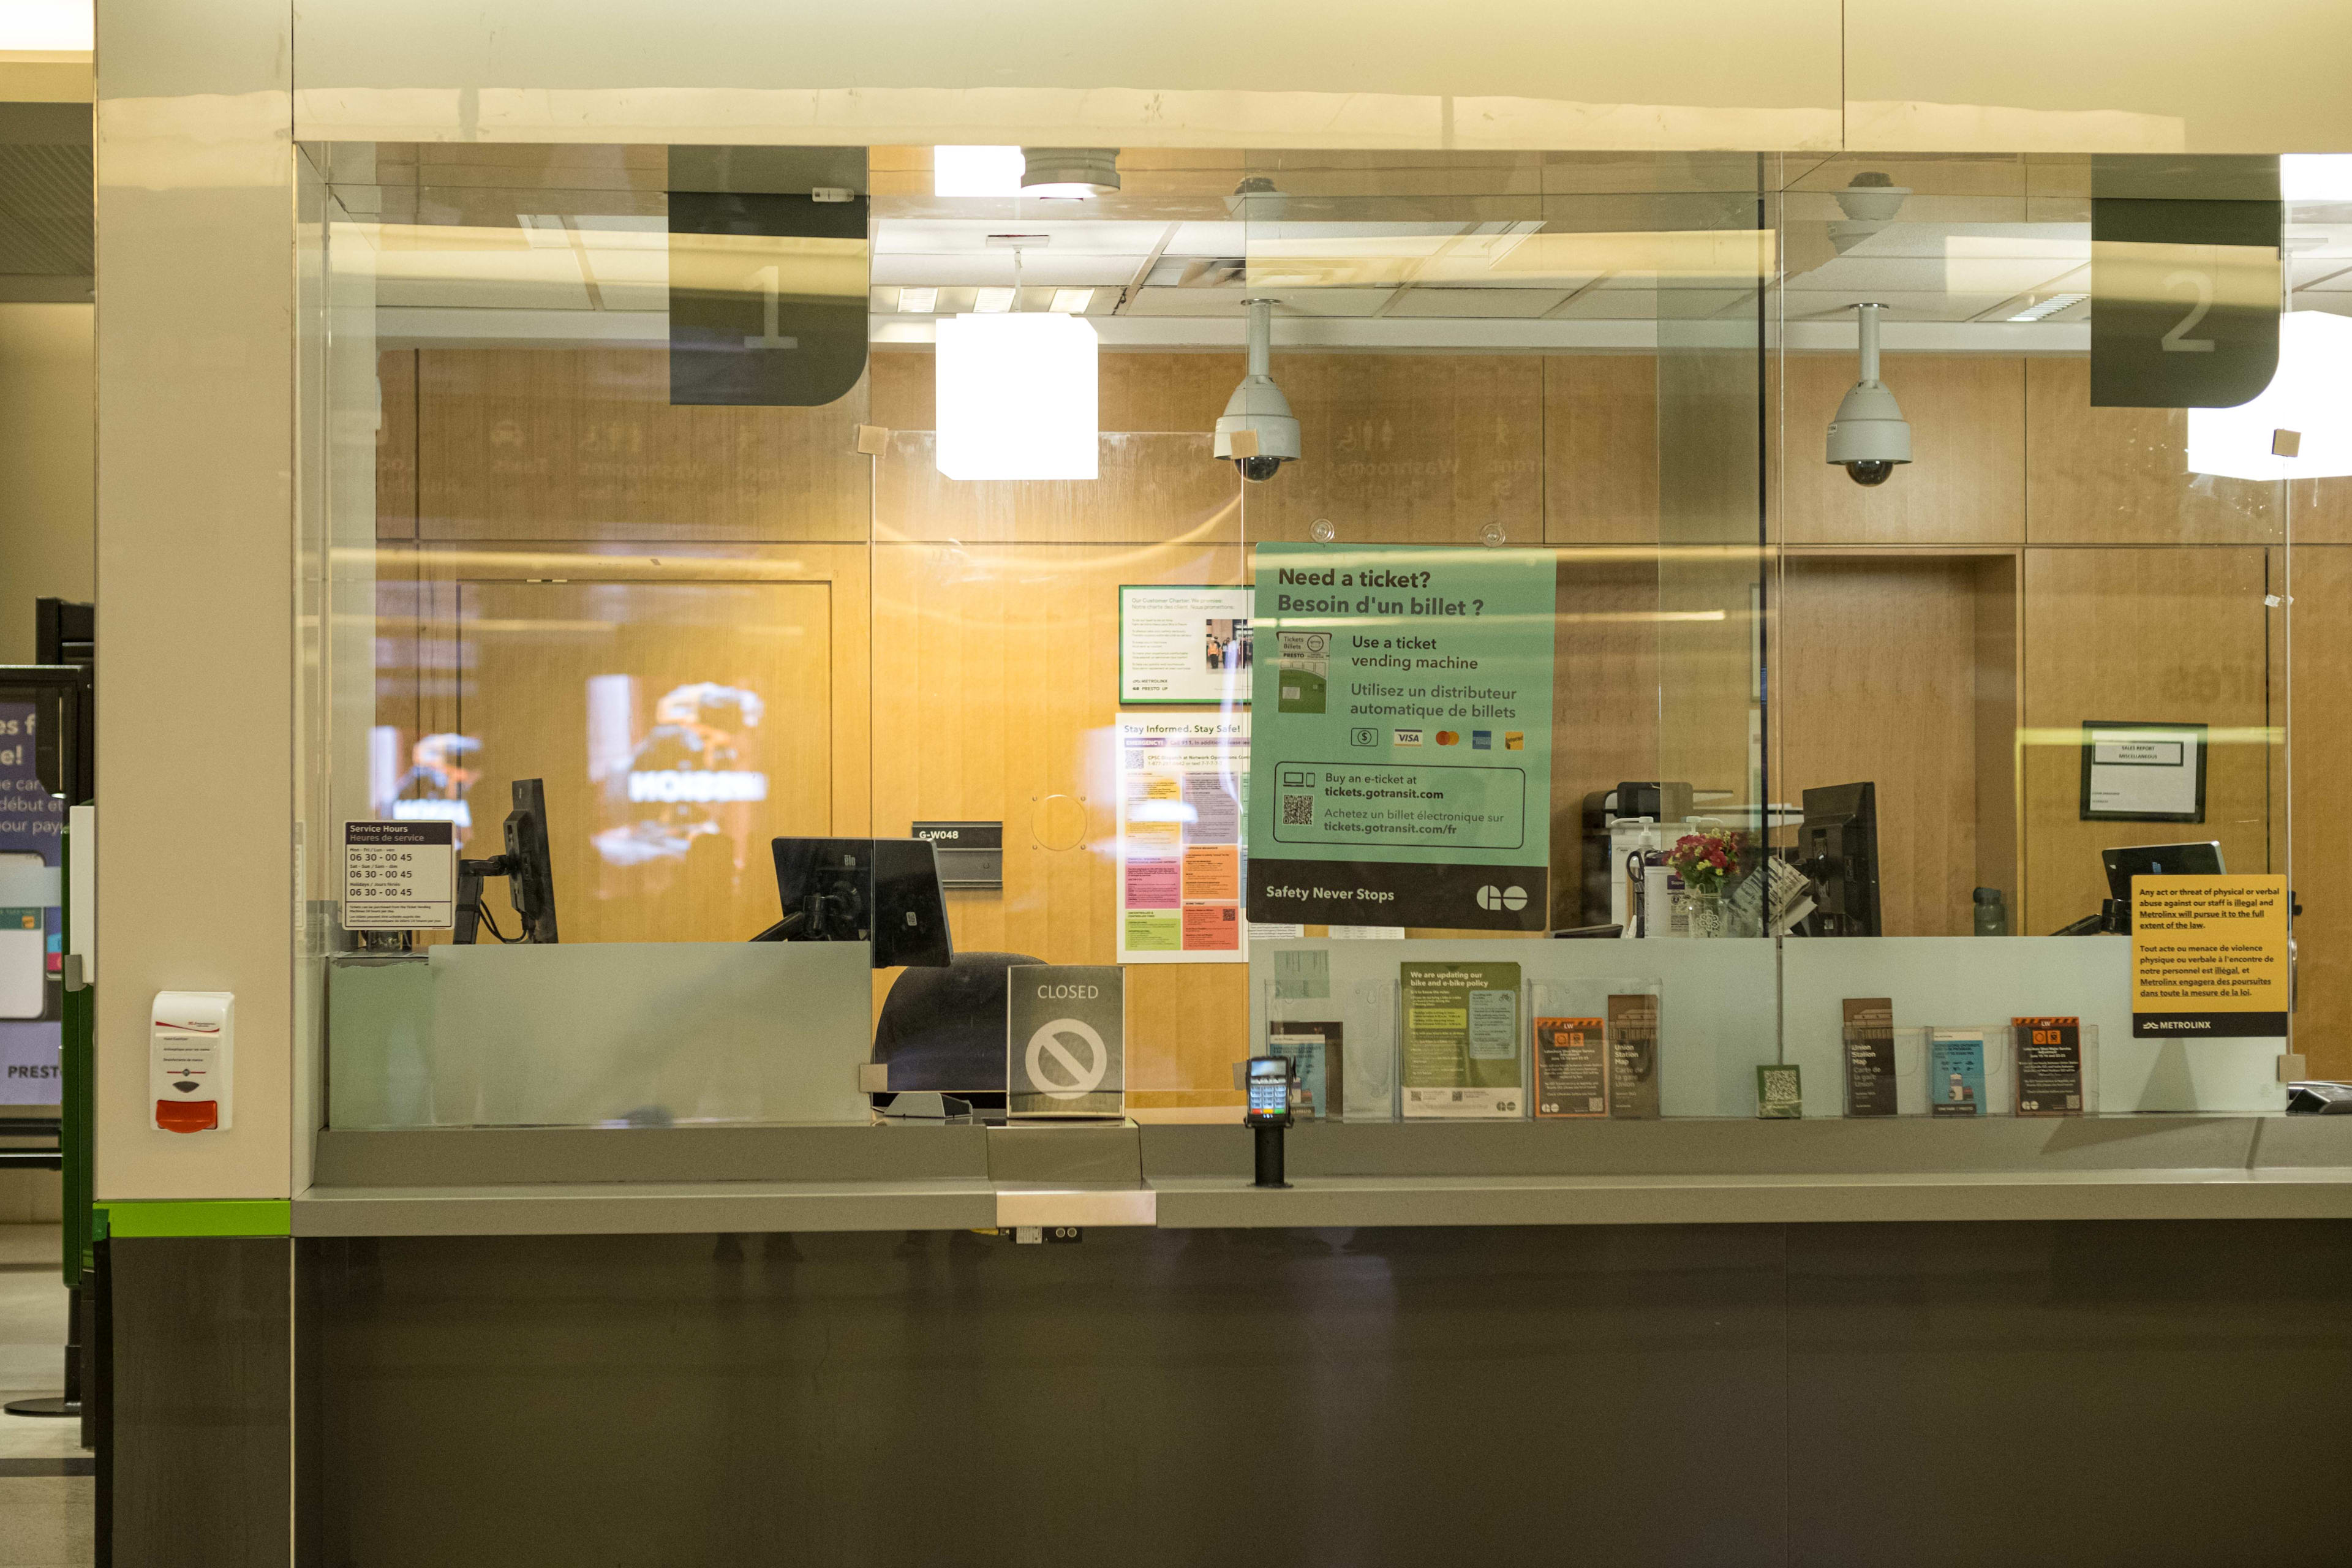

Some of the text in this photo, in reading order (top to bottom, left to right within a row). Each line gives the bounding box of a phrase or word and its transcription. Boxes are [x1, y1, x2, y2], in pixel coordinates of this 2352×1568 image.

[741, 266, 797, 349] 1
[2161, 270, 2215, 352] 2
[1279, 568, 1431, 588] Need a ticket?
[1278, 595, 1348, 612] Besoin
[1356, 597, 1403, 614] d'un
[1411, 597, 1466, 615] billet
[1353, 636, 1437, 649] Use a ticket
[1351, 656, 1478, 671] vending machine
[1351, 684, 1517, 699] Utilisez un distributeur
[1351, 704, 1515, 718] automatique de billets
[1125, 726, 1144, 734] Stay
[1326, 773, 1345, 785] Buy
[1365, 774, 1403, 784] e-ticket
[1406, 775, 1417, 784] at
[1325, 787, 1444, 800] tickets.gotransit.com
[1325, 809, 1367, 818] Achetez
[1387, 810, 1414, 820] billet
[1417, 812, 1484, 823] électronique
[1324, 822, 1457, 835] tickets.gotransit.com/fr
[1267, 886, 1394, 902] Safety Never Stops
[1038, 985, 1098, 998] CLOSED
[8, 1065, 61, 1079] PREST
